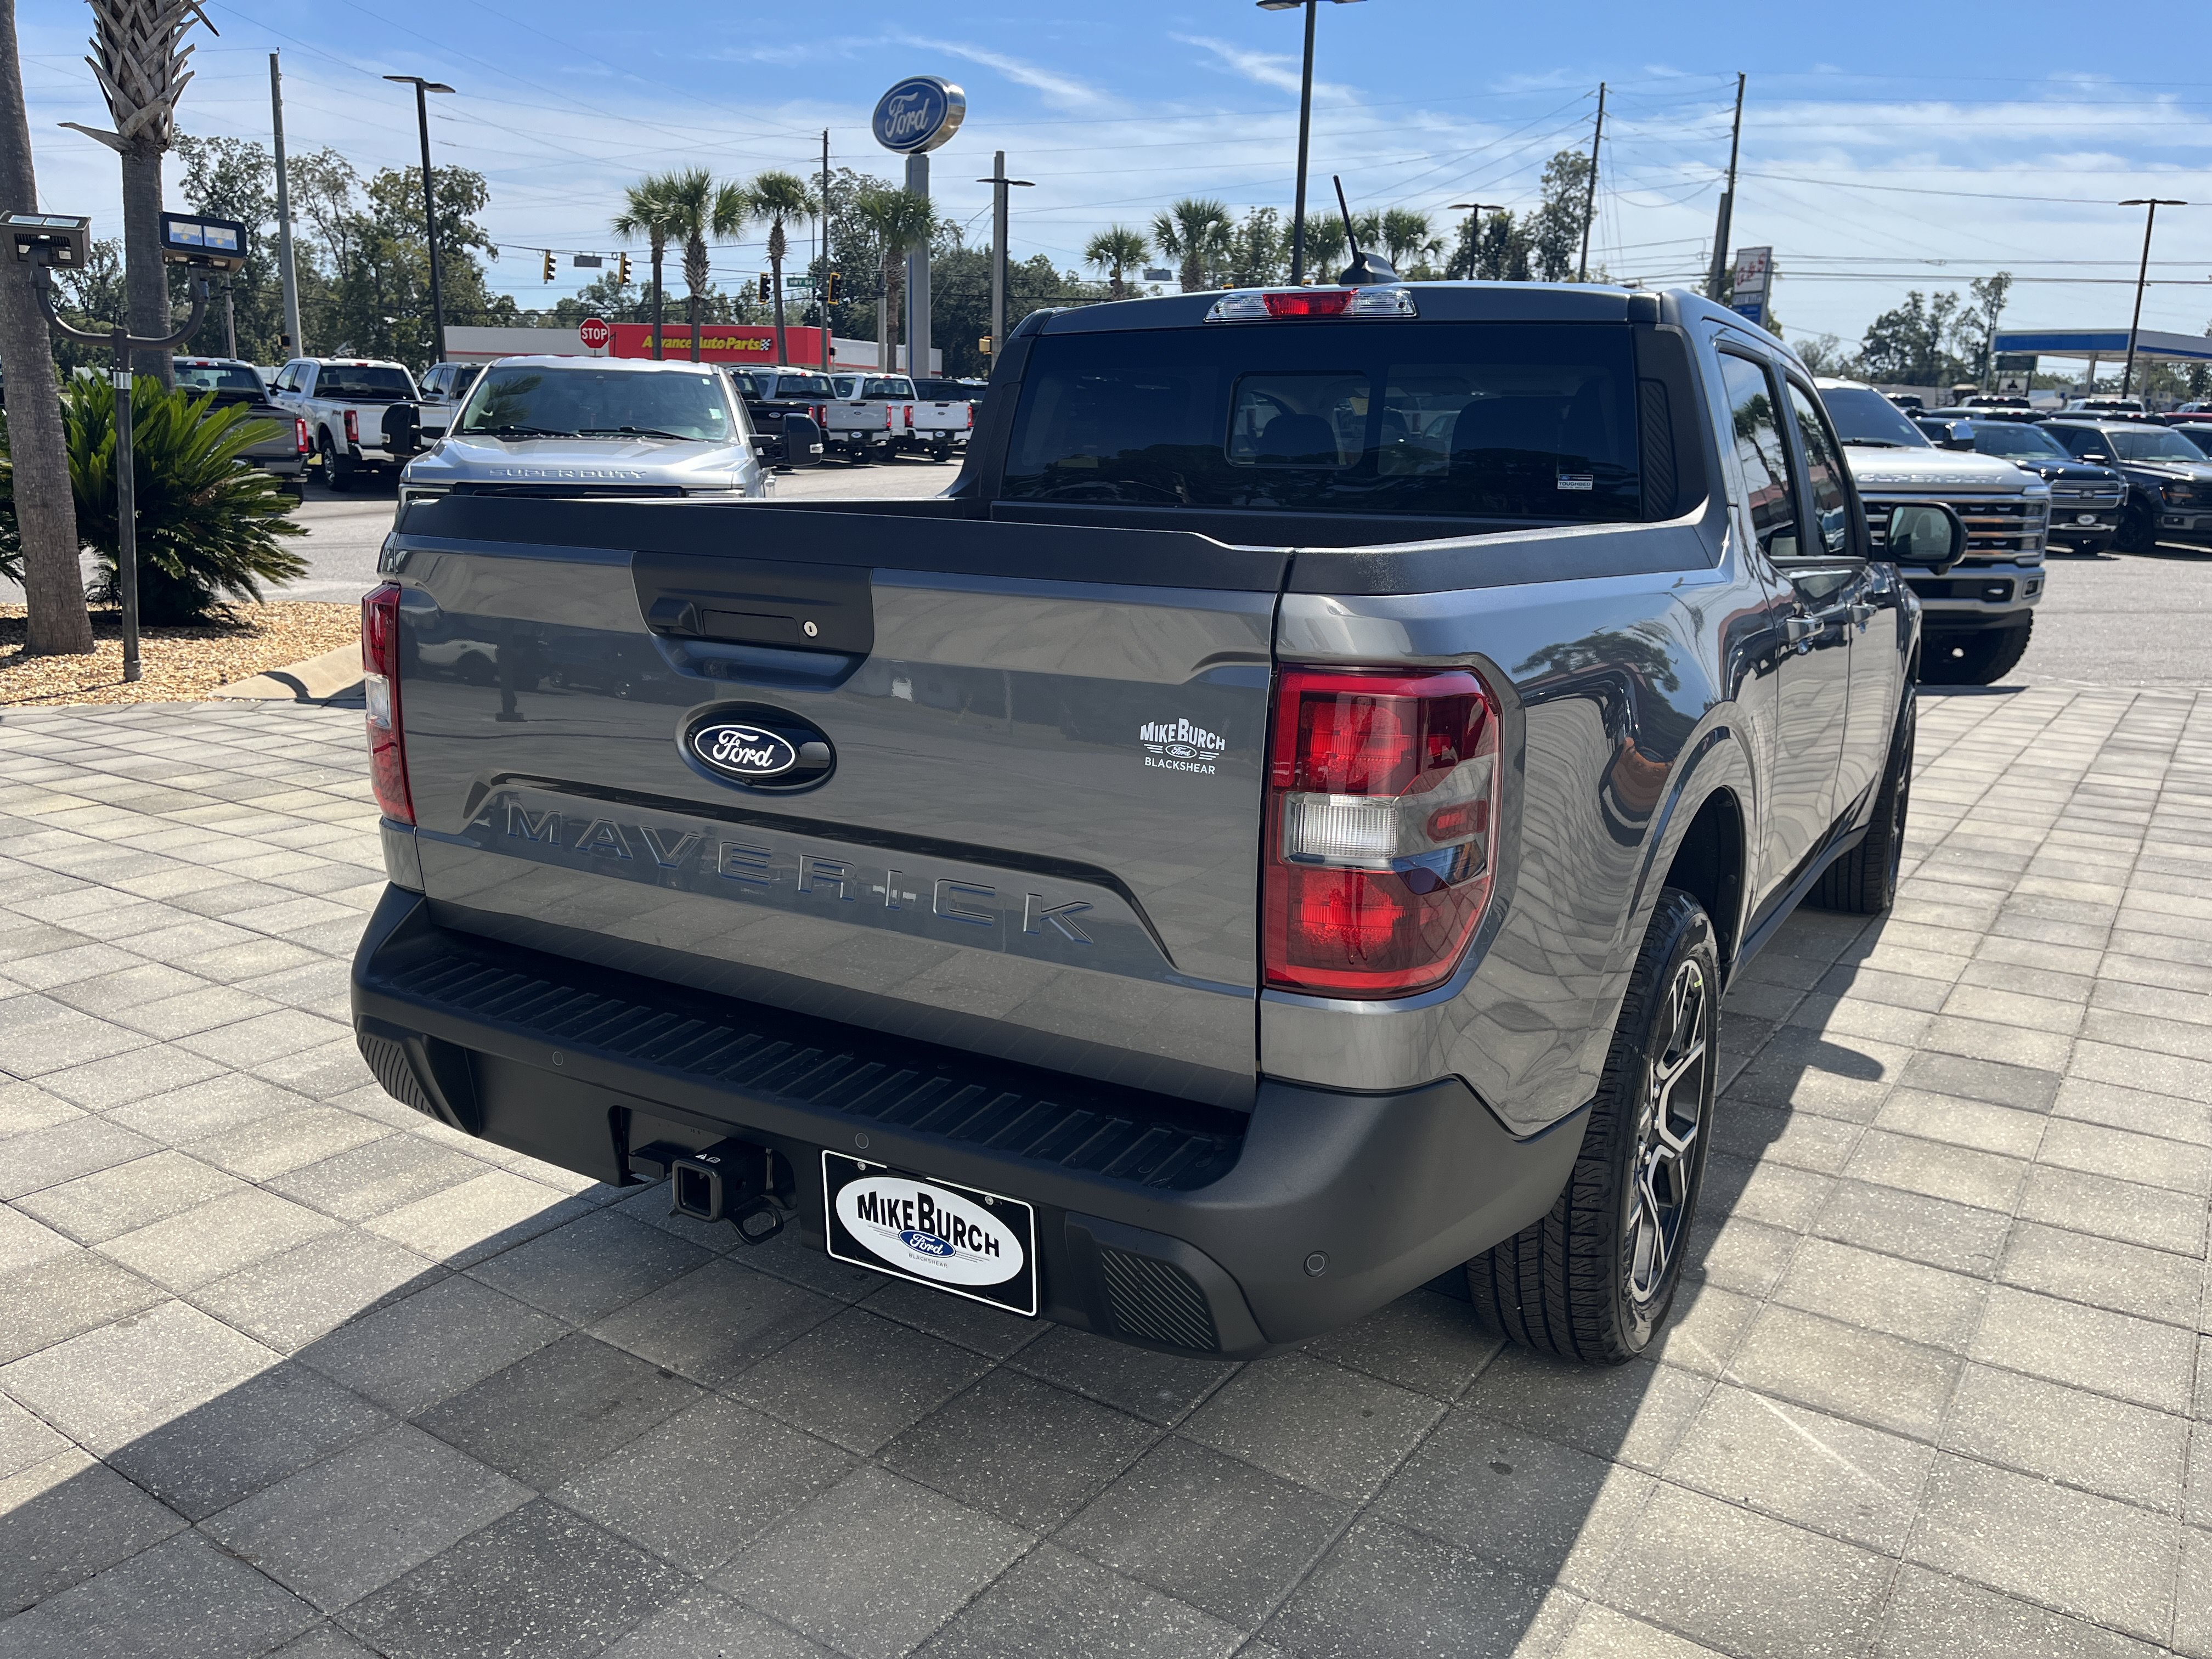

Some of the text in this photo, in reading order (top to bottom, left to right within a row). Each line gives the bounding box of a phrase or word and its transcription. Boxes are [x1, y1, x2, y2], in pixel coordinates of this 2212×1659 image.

[885, 92, 930, 138] Ford
[581, 328, 607, 340] STOP
[641, 335, 691, 348] Avance
[725, 336, 761, 351] Parts
[489, 469, 647, 478] SUPER DUTY
[713, 730, 775, 767] Ford
[1171, 746, 1191, 757] Ford
[1144, 757, 1216, 775] BLACKSHEAR
[507, 802, 1094, 944] MAVERICK
[909, 1233, 944, 1255] Ford
[908, 1252, 948, 1268] BLACKSHEAR
